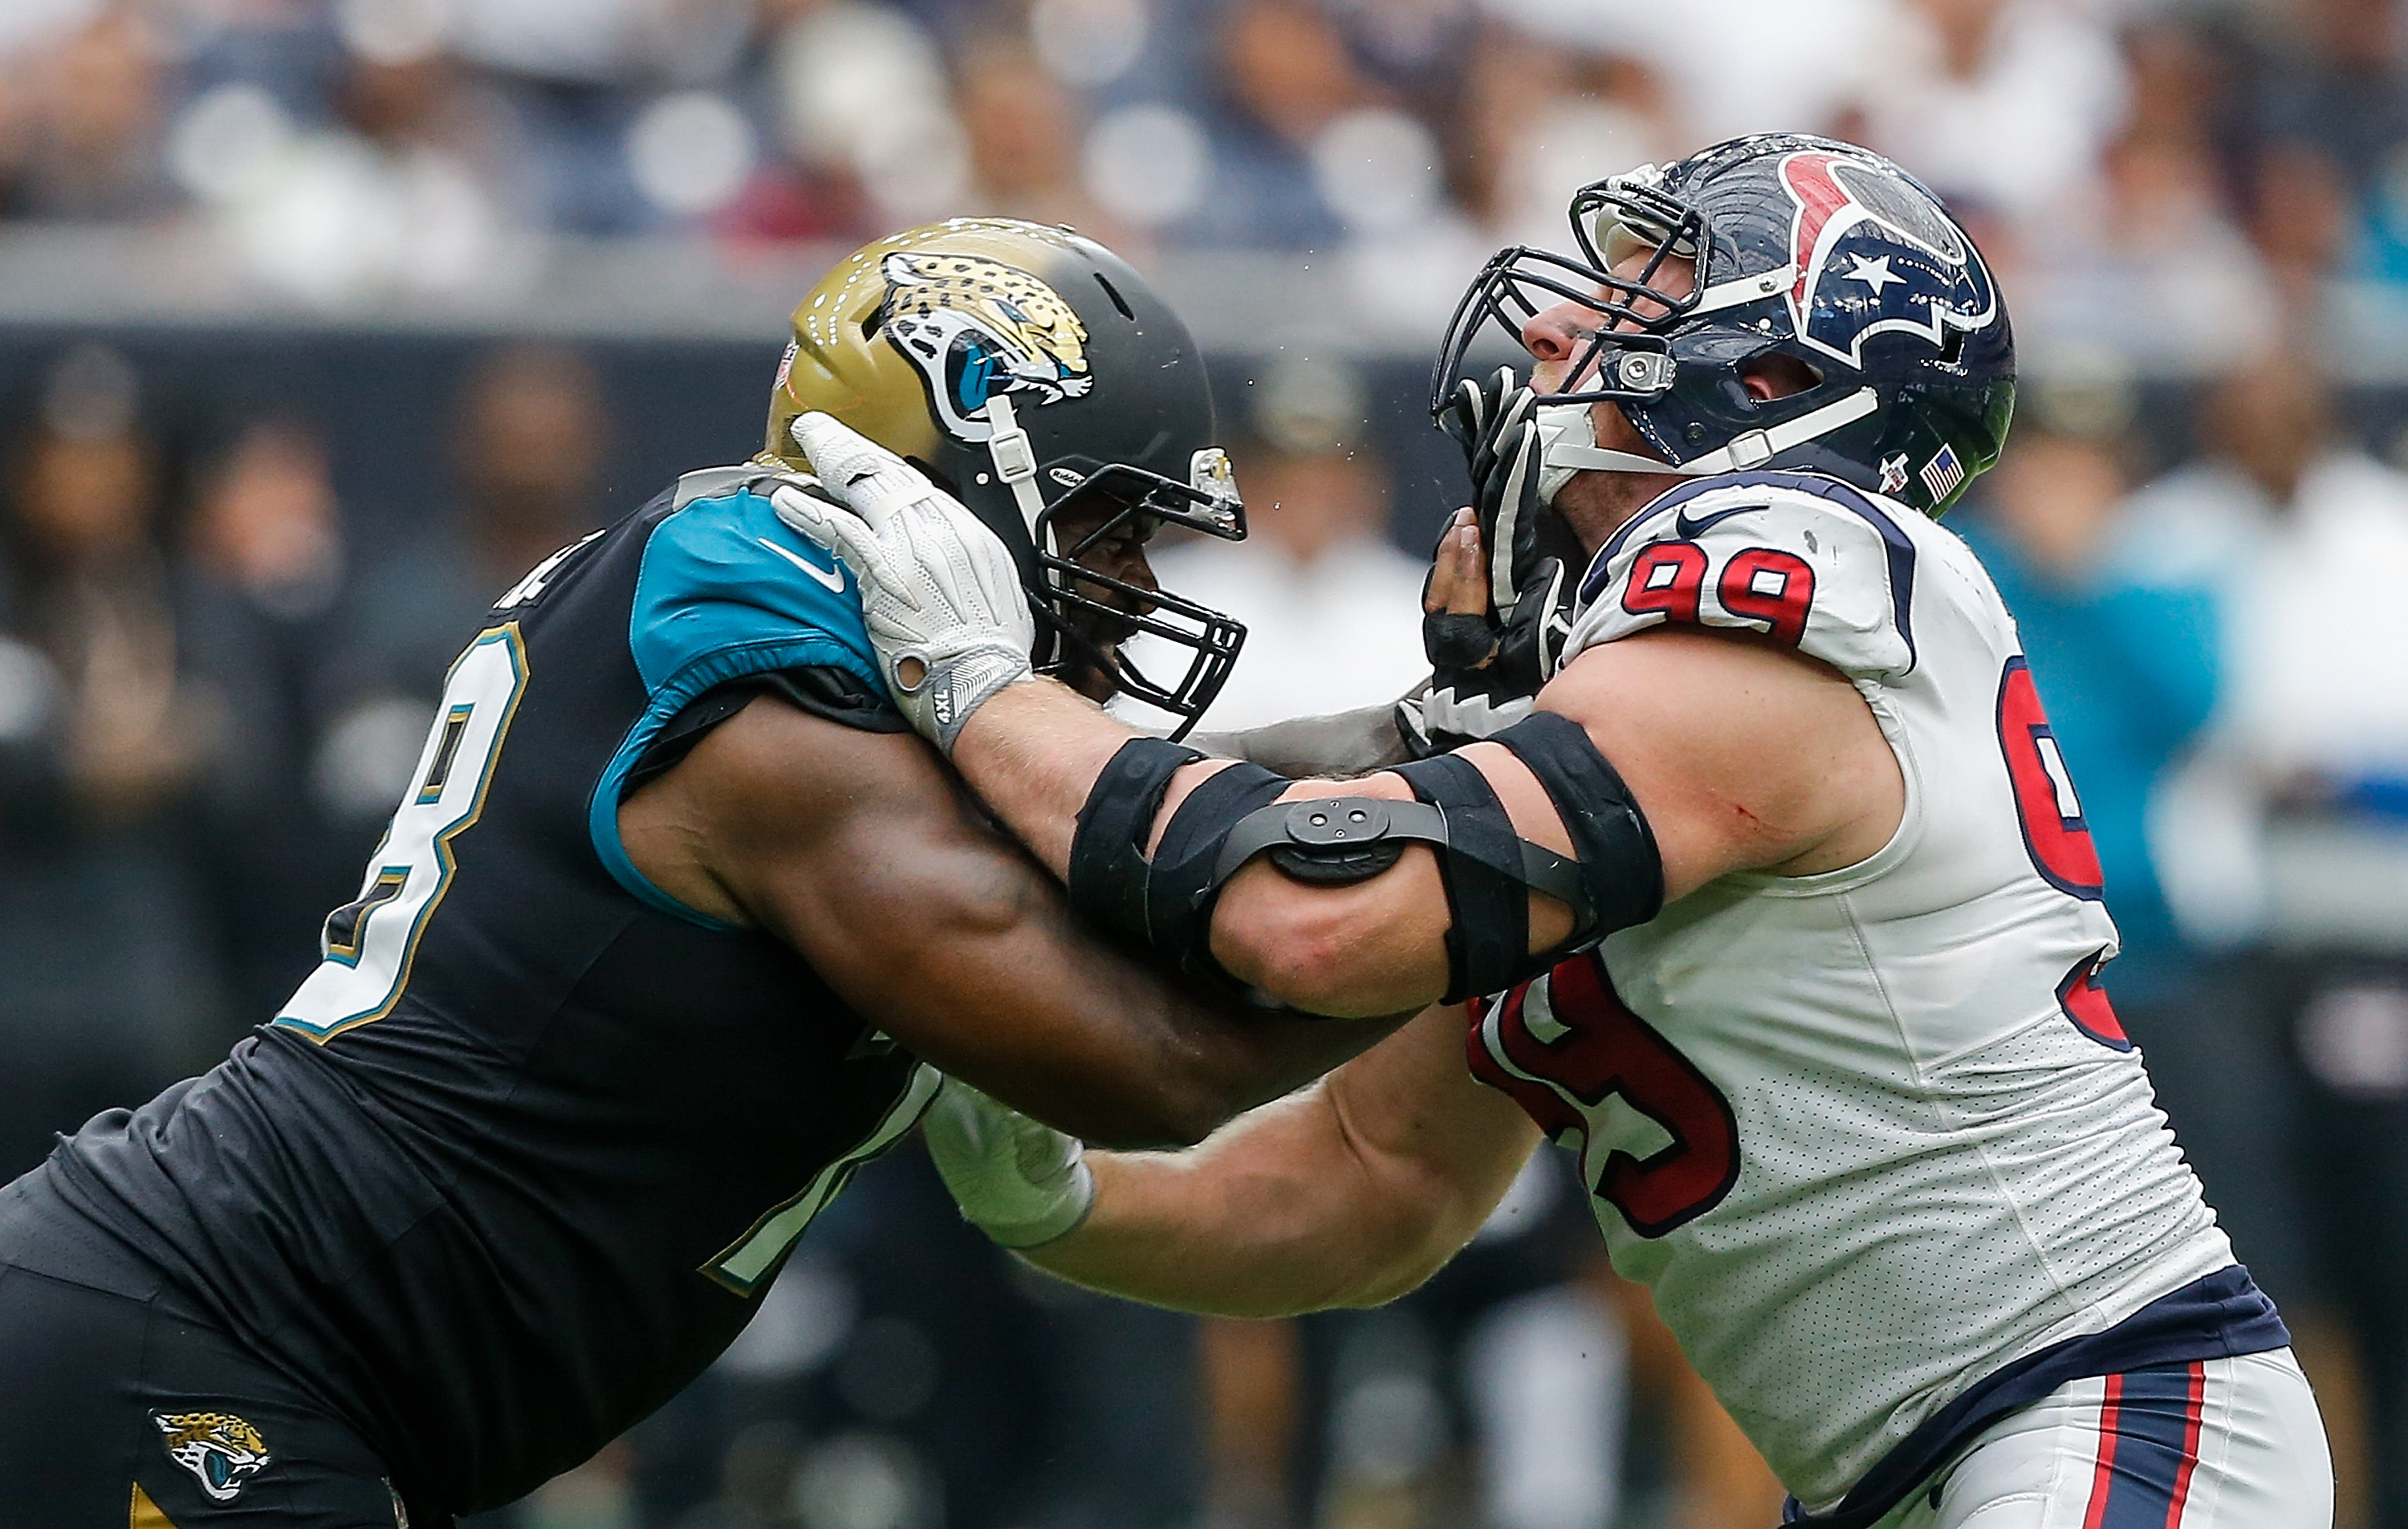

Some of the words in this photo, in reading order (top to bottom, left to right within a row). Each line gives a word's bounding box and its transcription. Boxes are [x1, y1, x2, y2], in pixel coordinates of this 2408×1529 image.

[1052, 470, 1085, 486] Ridde
[1621, 539, 1816, 648] 99
[934, 688, 951, 723] 4XL
